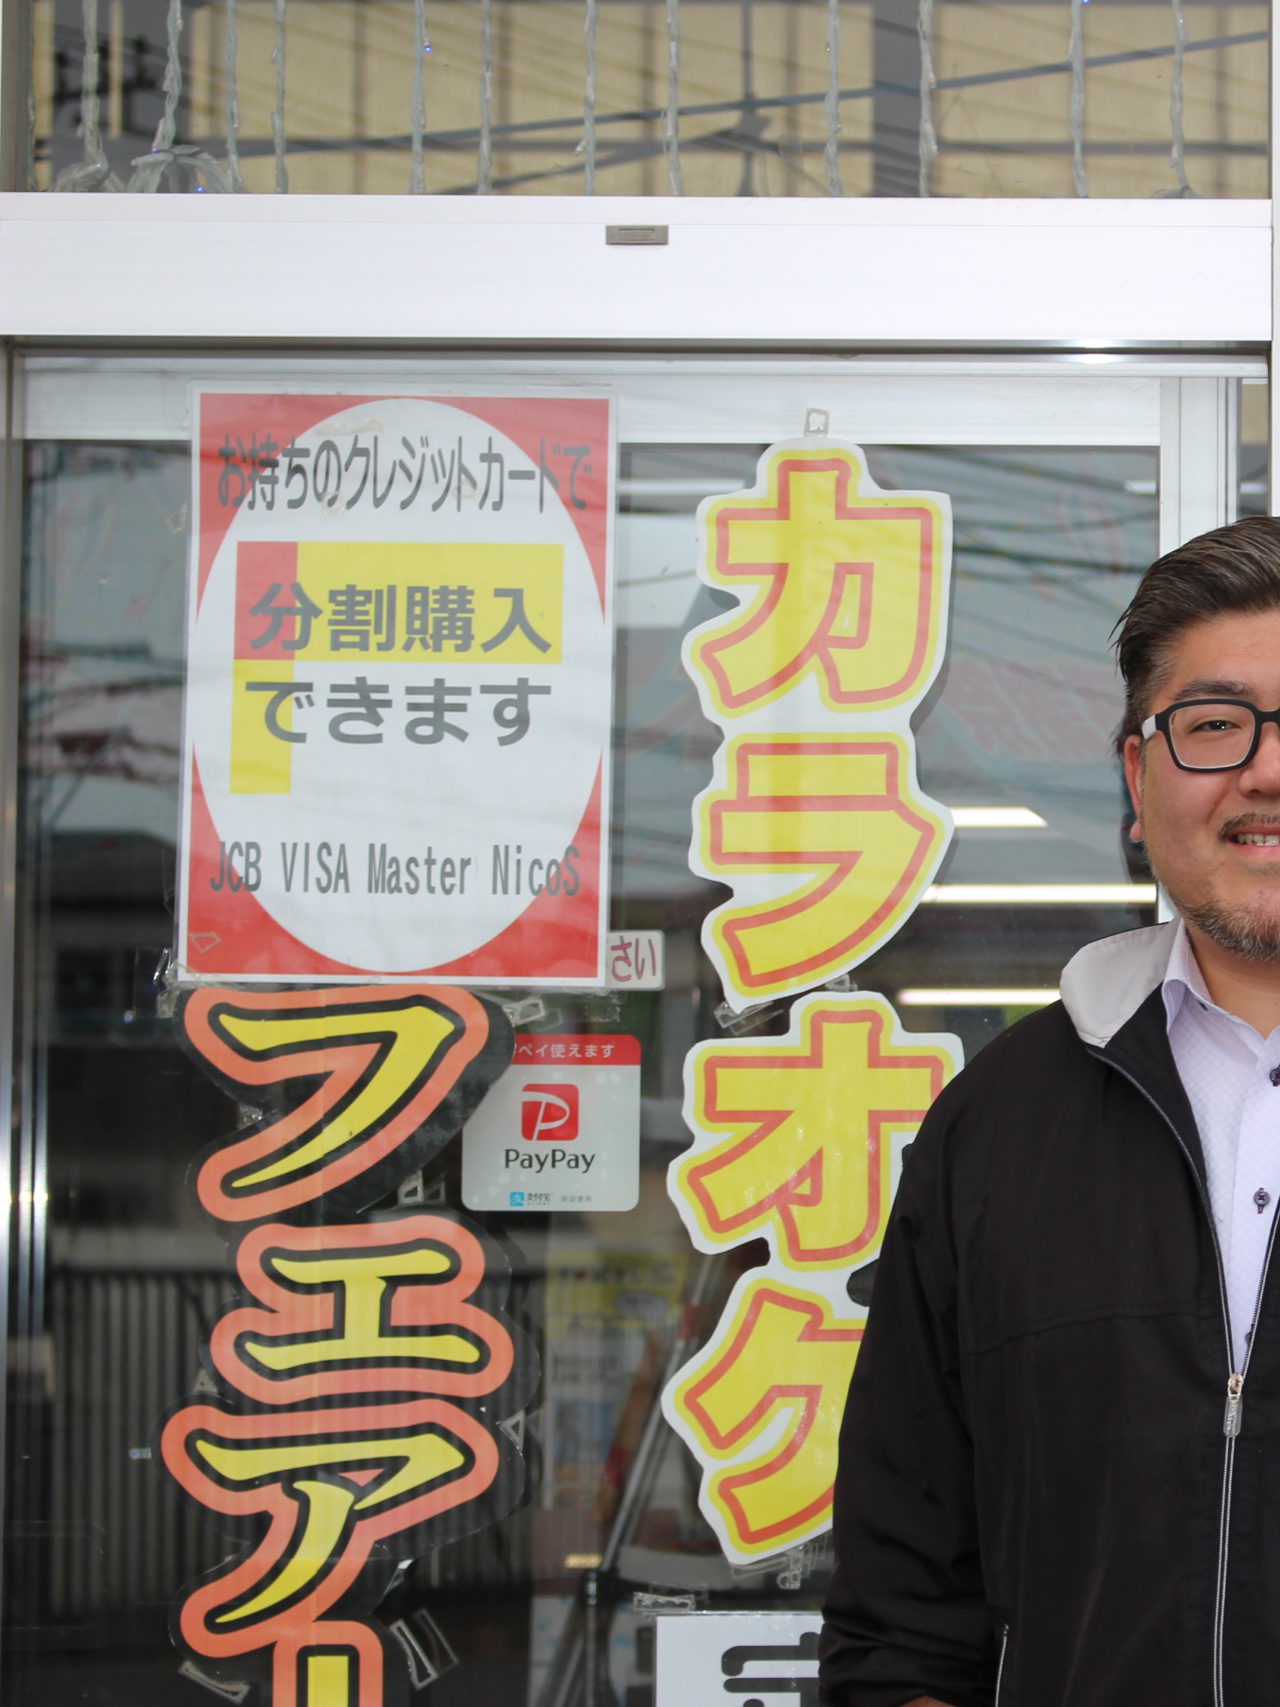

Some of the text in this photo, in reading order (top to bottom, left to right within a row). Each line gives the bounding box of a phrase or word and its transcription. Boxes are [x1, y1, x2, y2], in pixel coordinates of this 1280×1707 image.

[218, 433, 593, 514] お持ちのクレジットカードで
[248, 582, 553, 655] 分割購入
[245, 675, 553, 747] できます
[209, 840, 262, 894] JCB
[281, 841, 350, 894] VISA
[367, 842, 472, 896] Master
[610, 935, 657, 982] さい
[503, 1148, 596, 1174] PayPay
